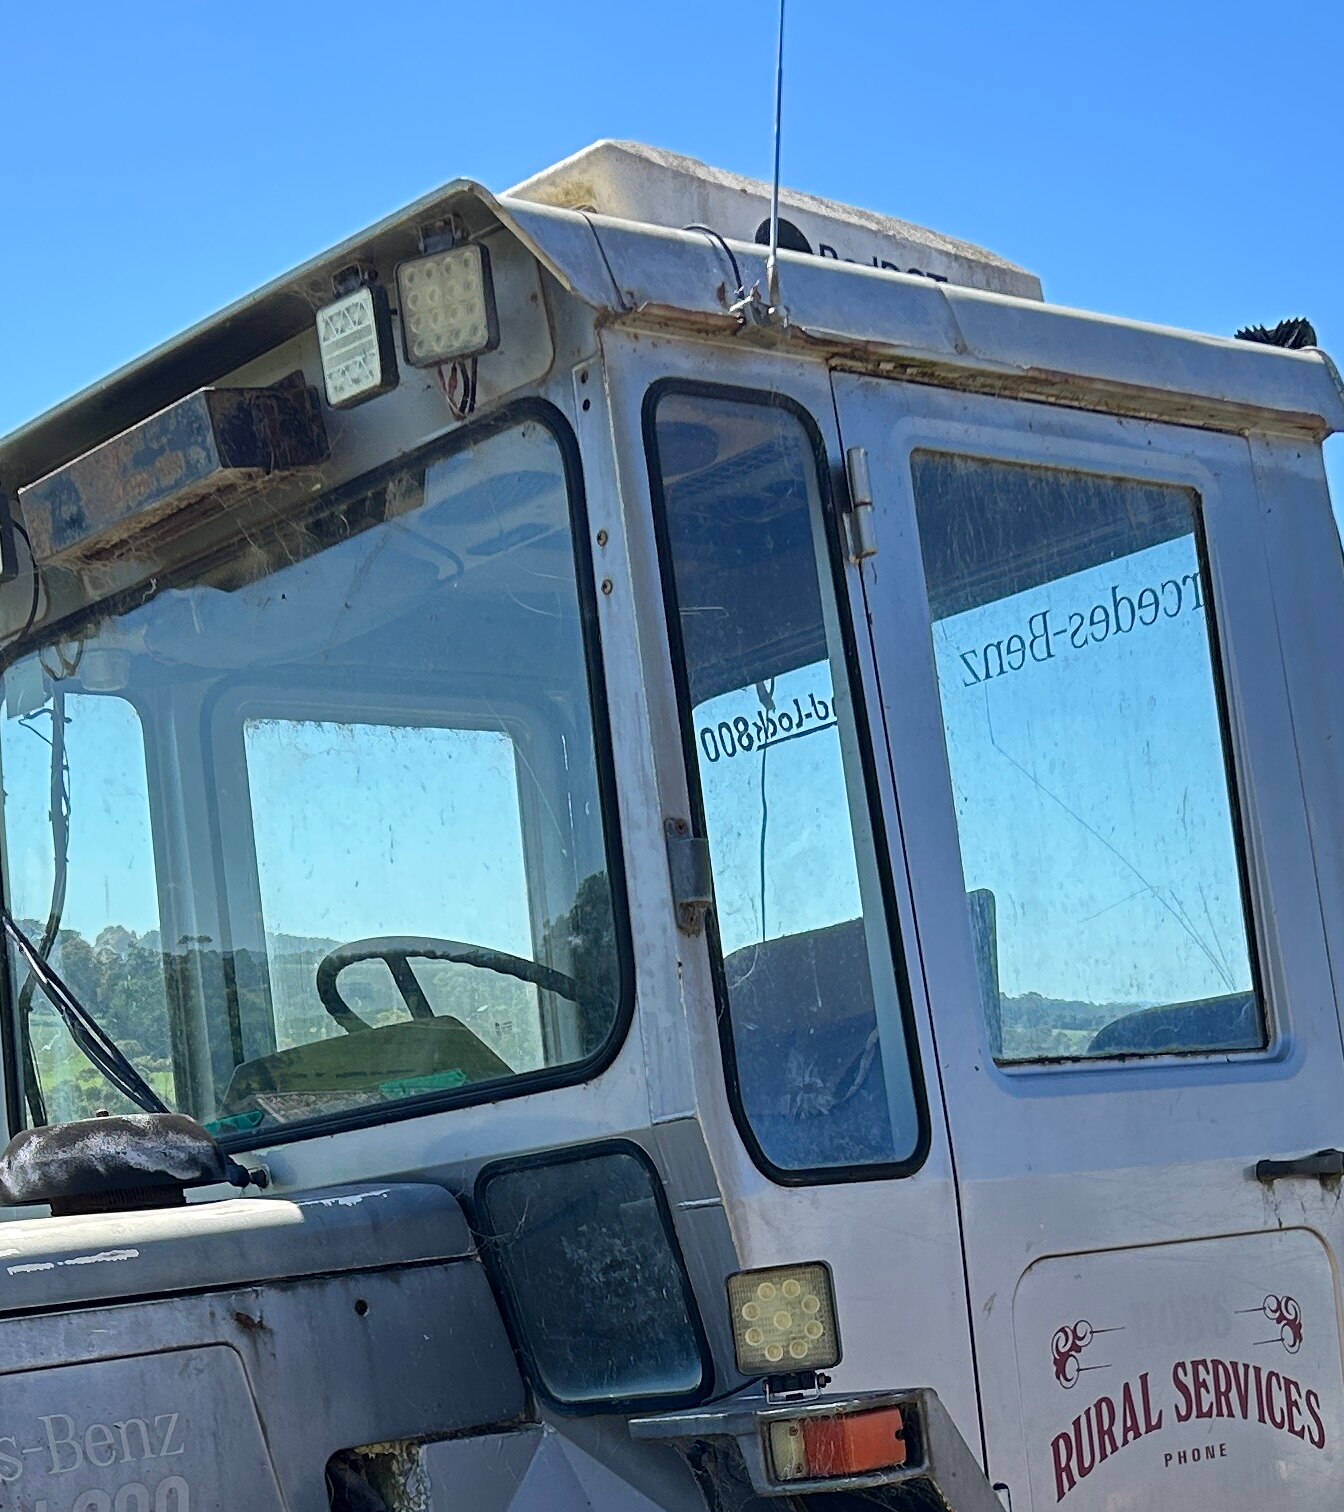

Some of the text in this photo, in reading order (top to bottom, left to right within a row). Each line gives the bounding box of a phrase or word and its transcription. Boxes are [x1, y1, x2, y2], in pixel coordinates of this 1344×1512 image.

[1050, 1357, 1327, 1504] RURAL SERVICES
[1163, 1442, 1229, 1468] PHONE
